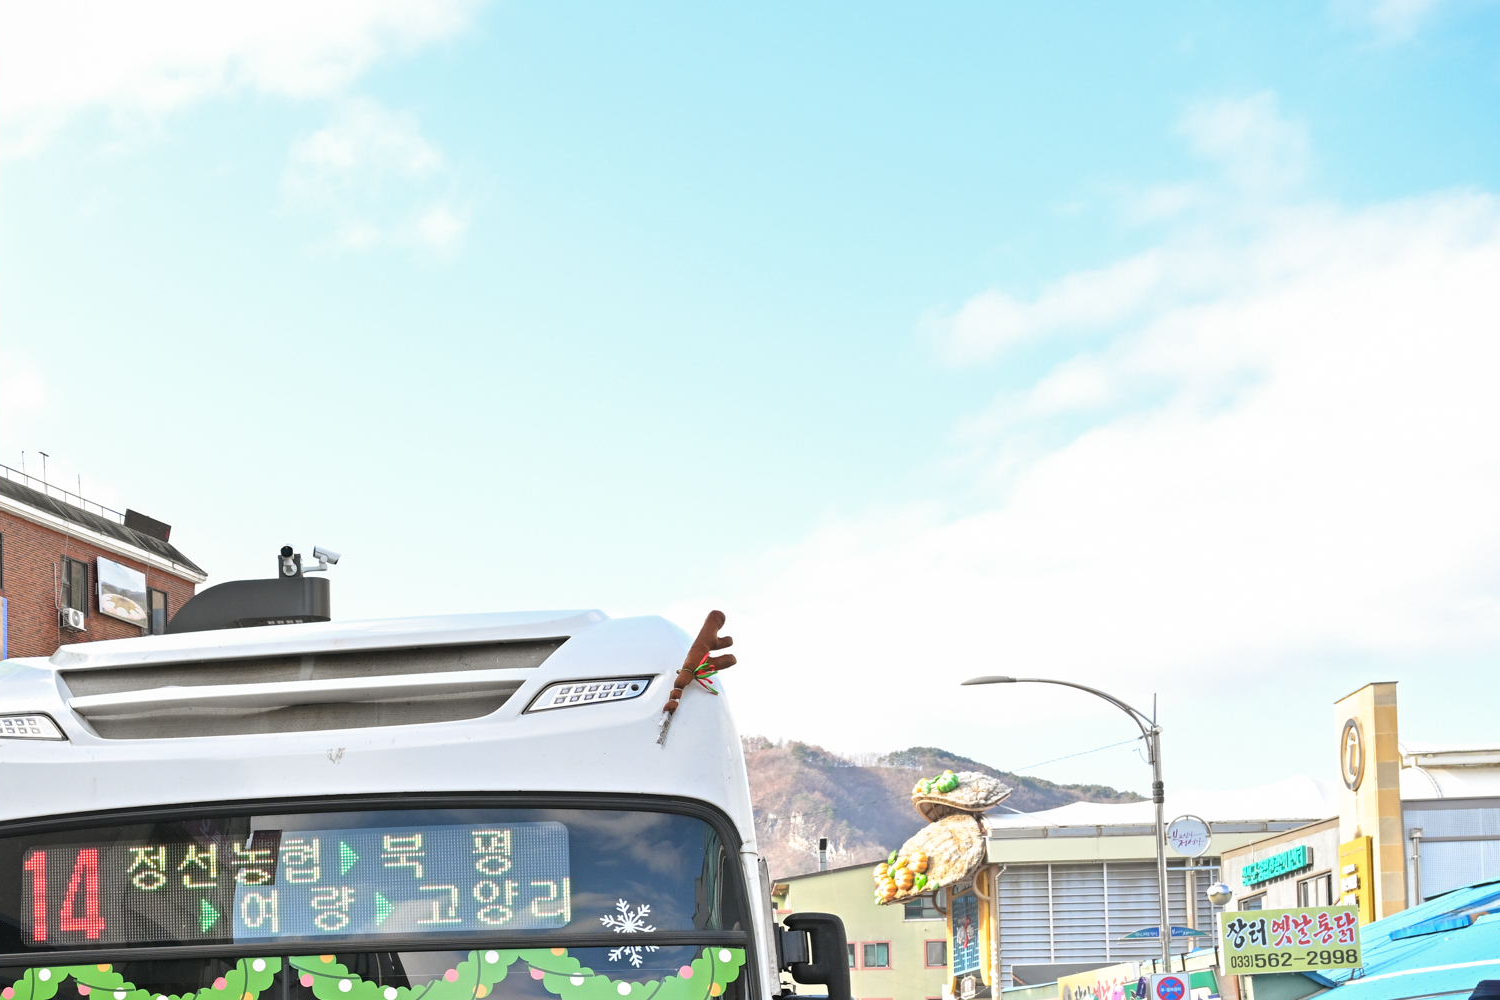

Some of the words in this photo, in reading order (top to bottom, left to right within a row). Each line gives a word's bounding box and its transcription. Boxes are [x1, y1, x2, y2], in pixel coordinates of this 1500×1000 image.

[127, 838, 320, 891] 정선농협
[24, 848, 105, 942] 14
[417, 877, 571, 925] 고양리
[1227, 917, 1268, 949] 장터
[1230, 948, 1358, 969] 033)562-2998
